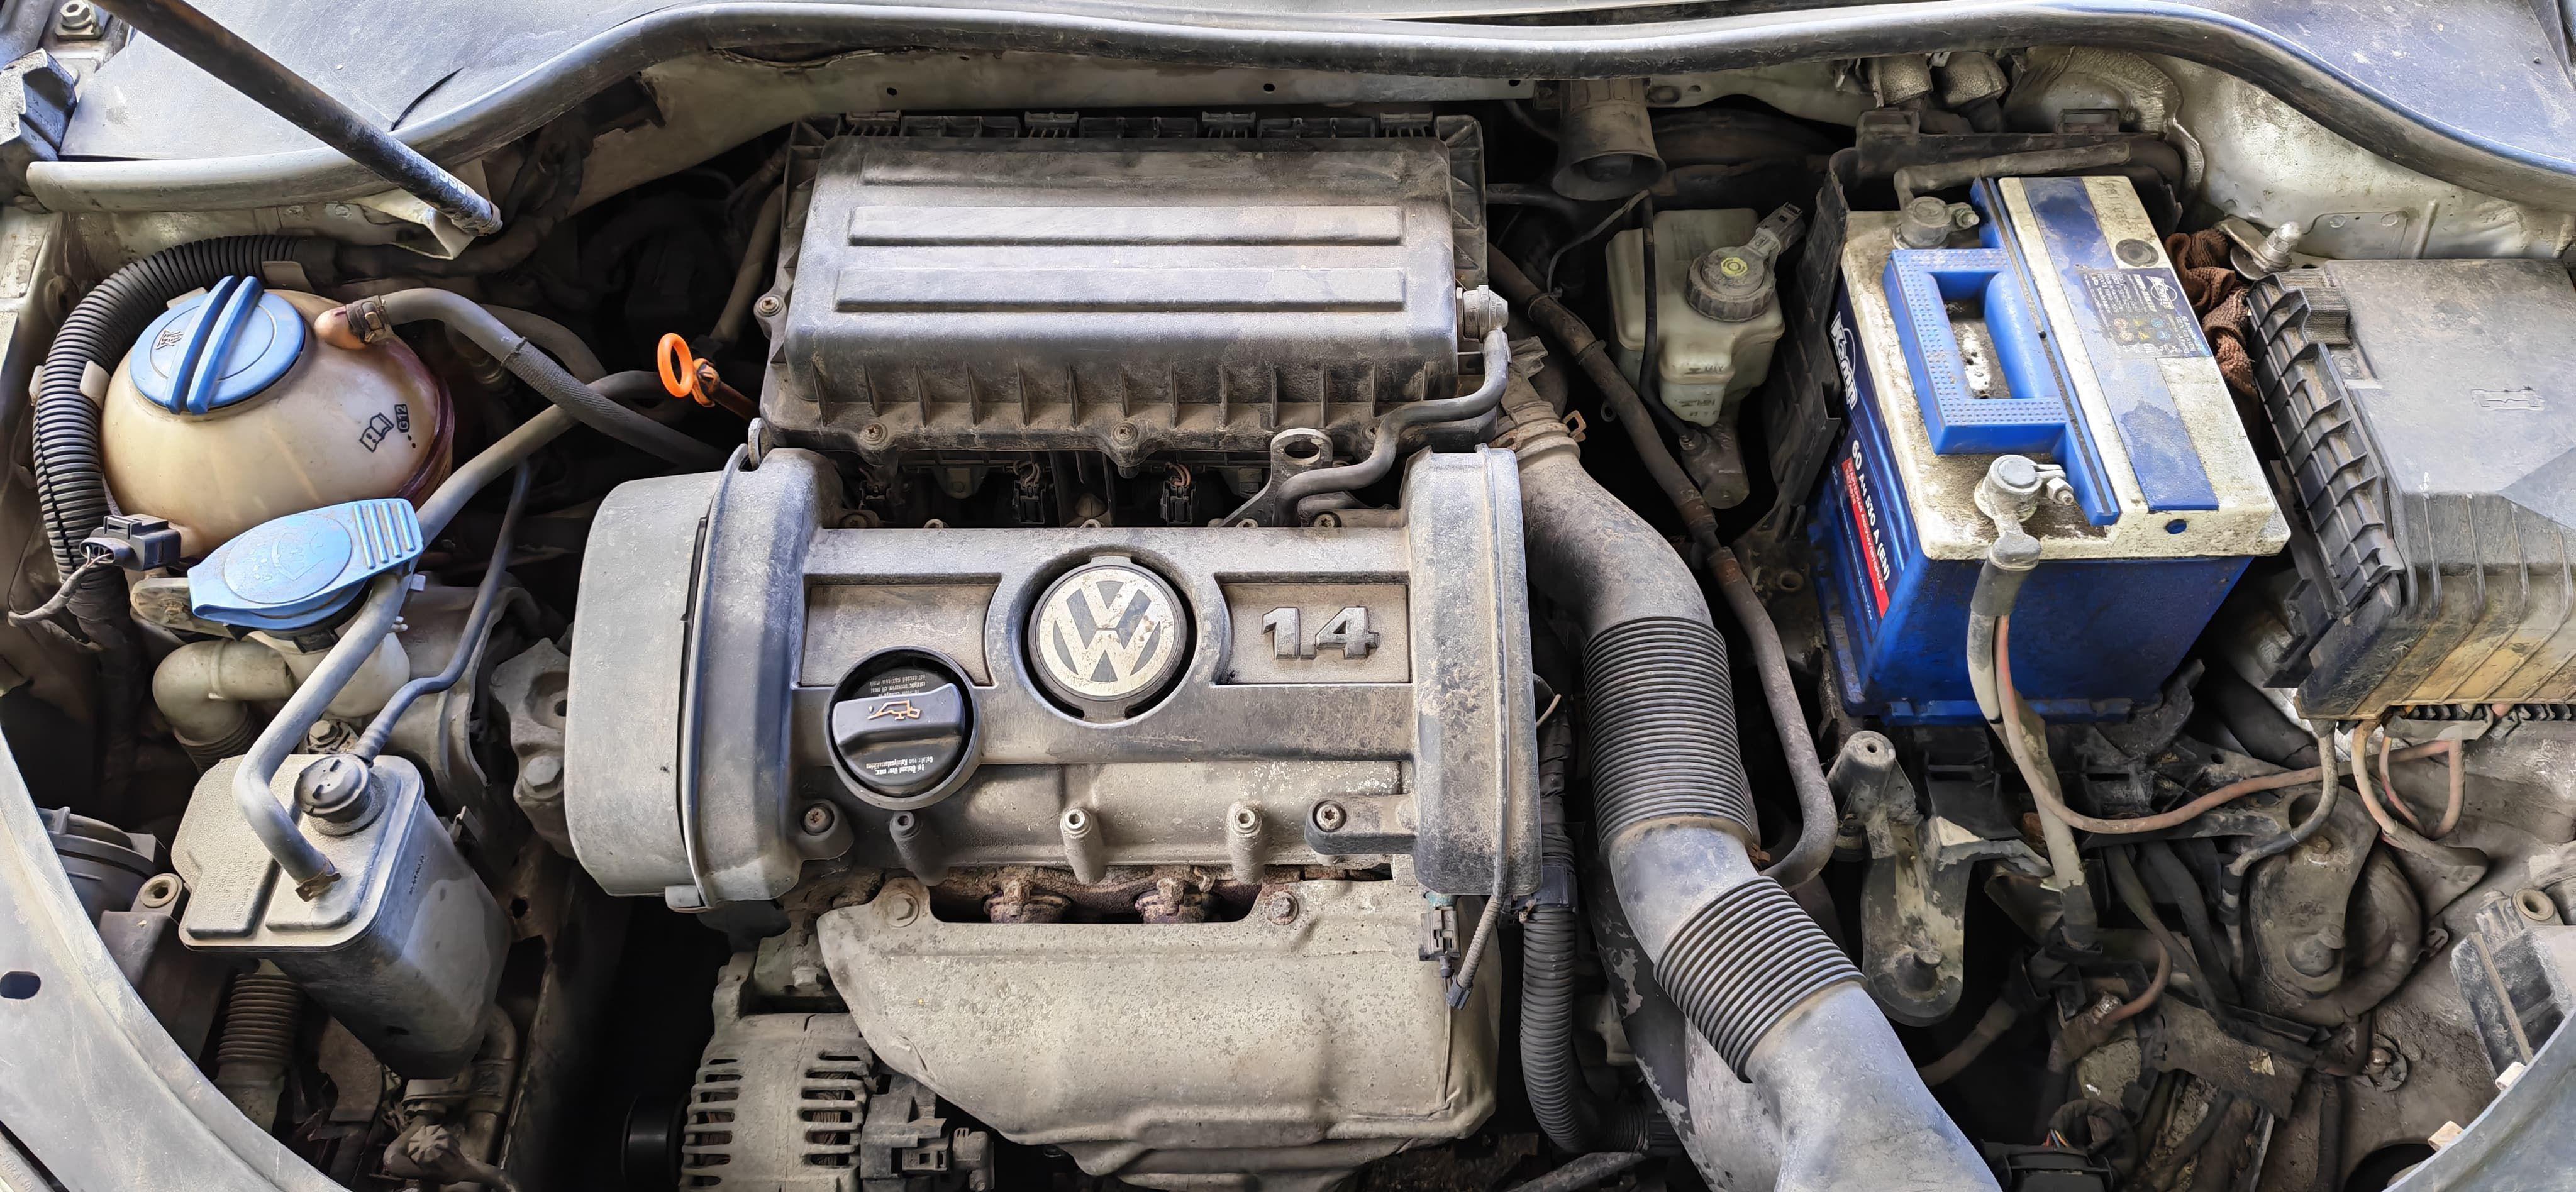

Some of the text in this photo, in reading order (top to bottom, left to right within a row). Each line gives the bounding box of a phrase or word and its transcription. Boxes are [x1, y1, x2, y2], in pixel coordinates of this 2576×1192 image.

[396, 404, 409, 431] G12
[1852, 440, 1862, 470] 60
[1865, 497, 1876, 526] 530
[1877, 543, 1890, 582] (EN)
[1038, 568, 1176, 697] VW
[1262, 607, 1380, 660] 1.4
